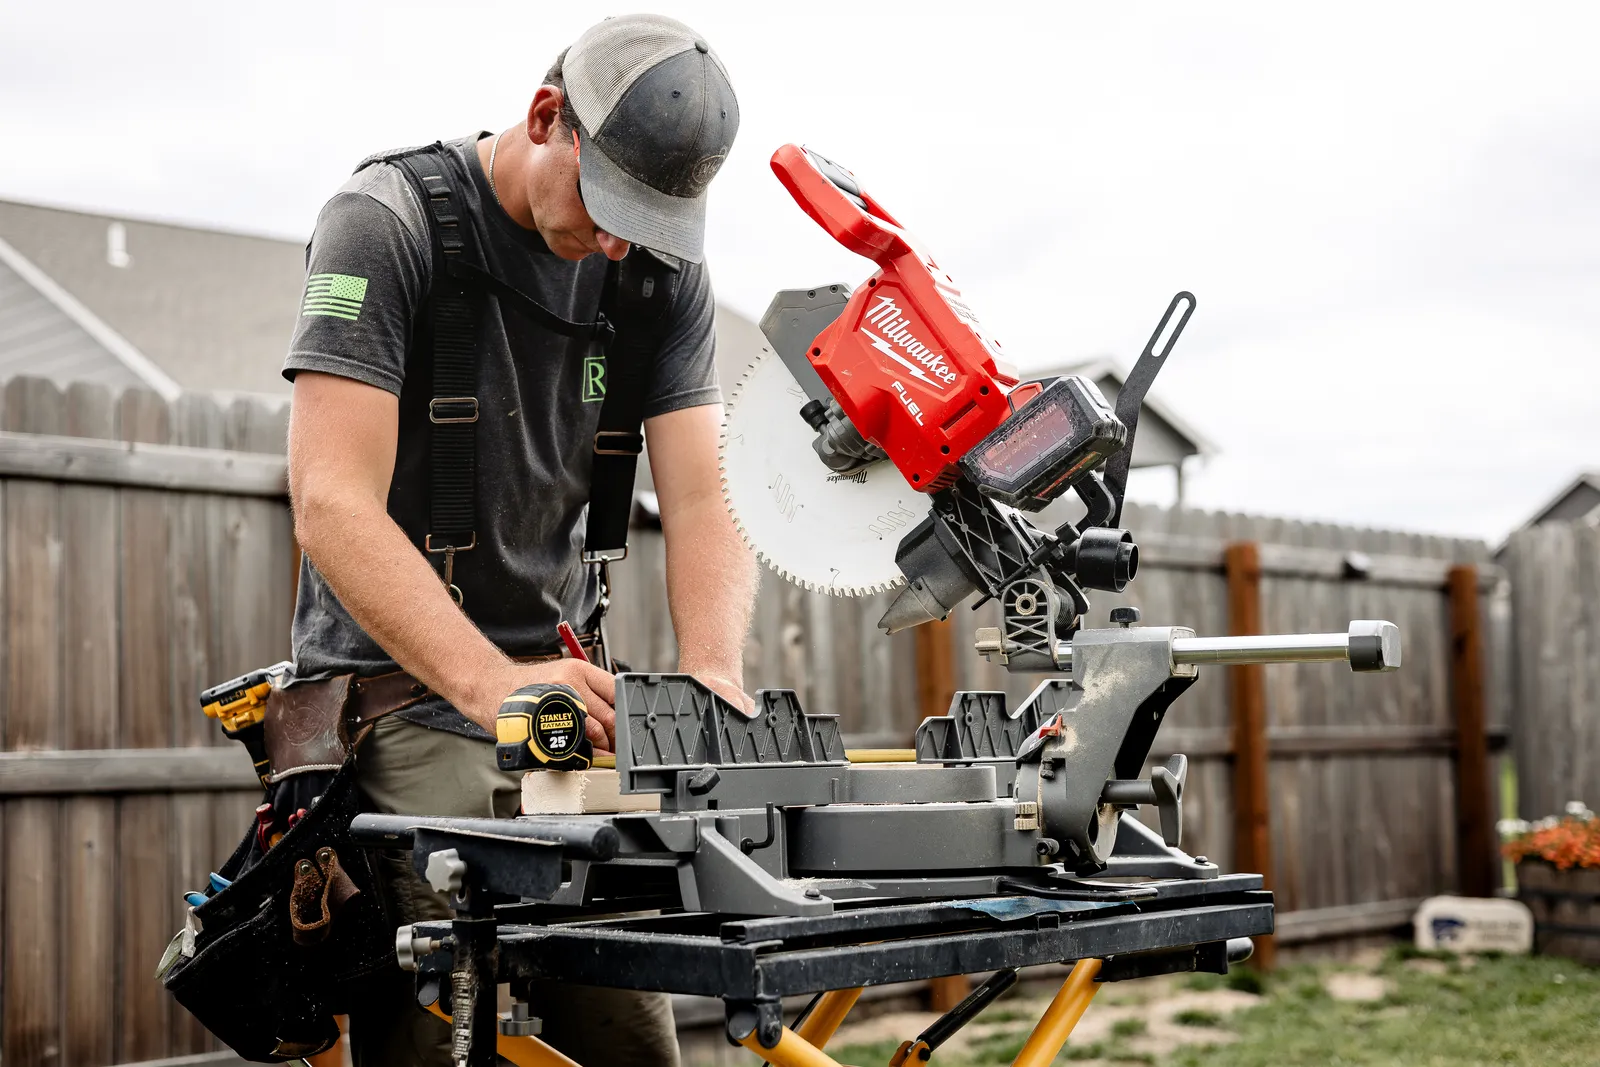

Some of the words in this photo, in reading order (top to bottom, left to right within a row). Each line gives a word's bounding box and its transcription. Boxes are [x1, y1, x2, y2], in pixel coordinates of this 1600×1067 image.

[865, 295, 957, 384] Milwaukee
[588, 362, 606, 396] R
[891, 380, 924, 426] FUEL
[826, 471, 868, 484] Milwaukee
[540, 712, 573, 722] STANLEY
[542, 721, 572, 729] FATMAX
